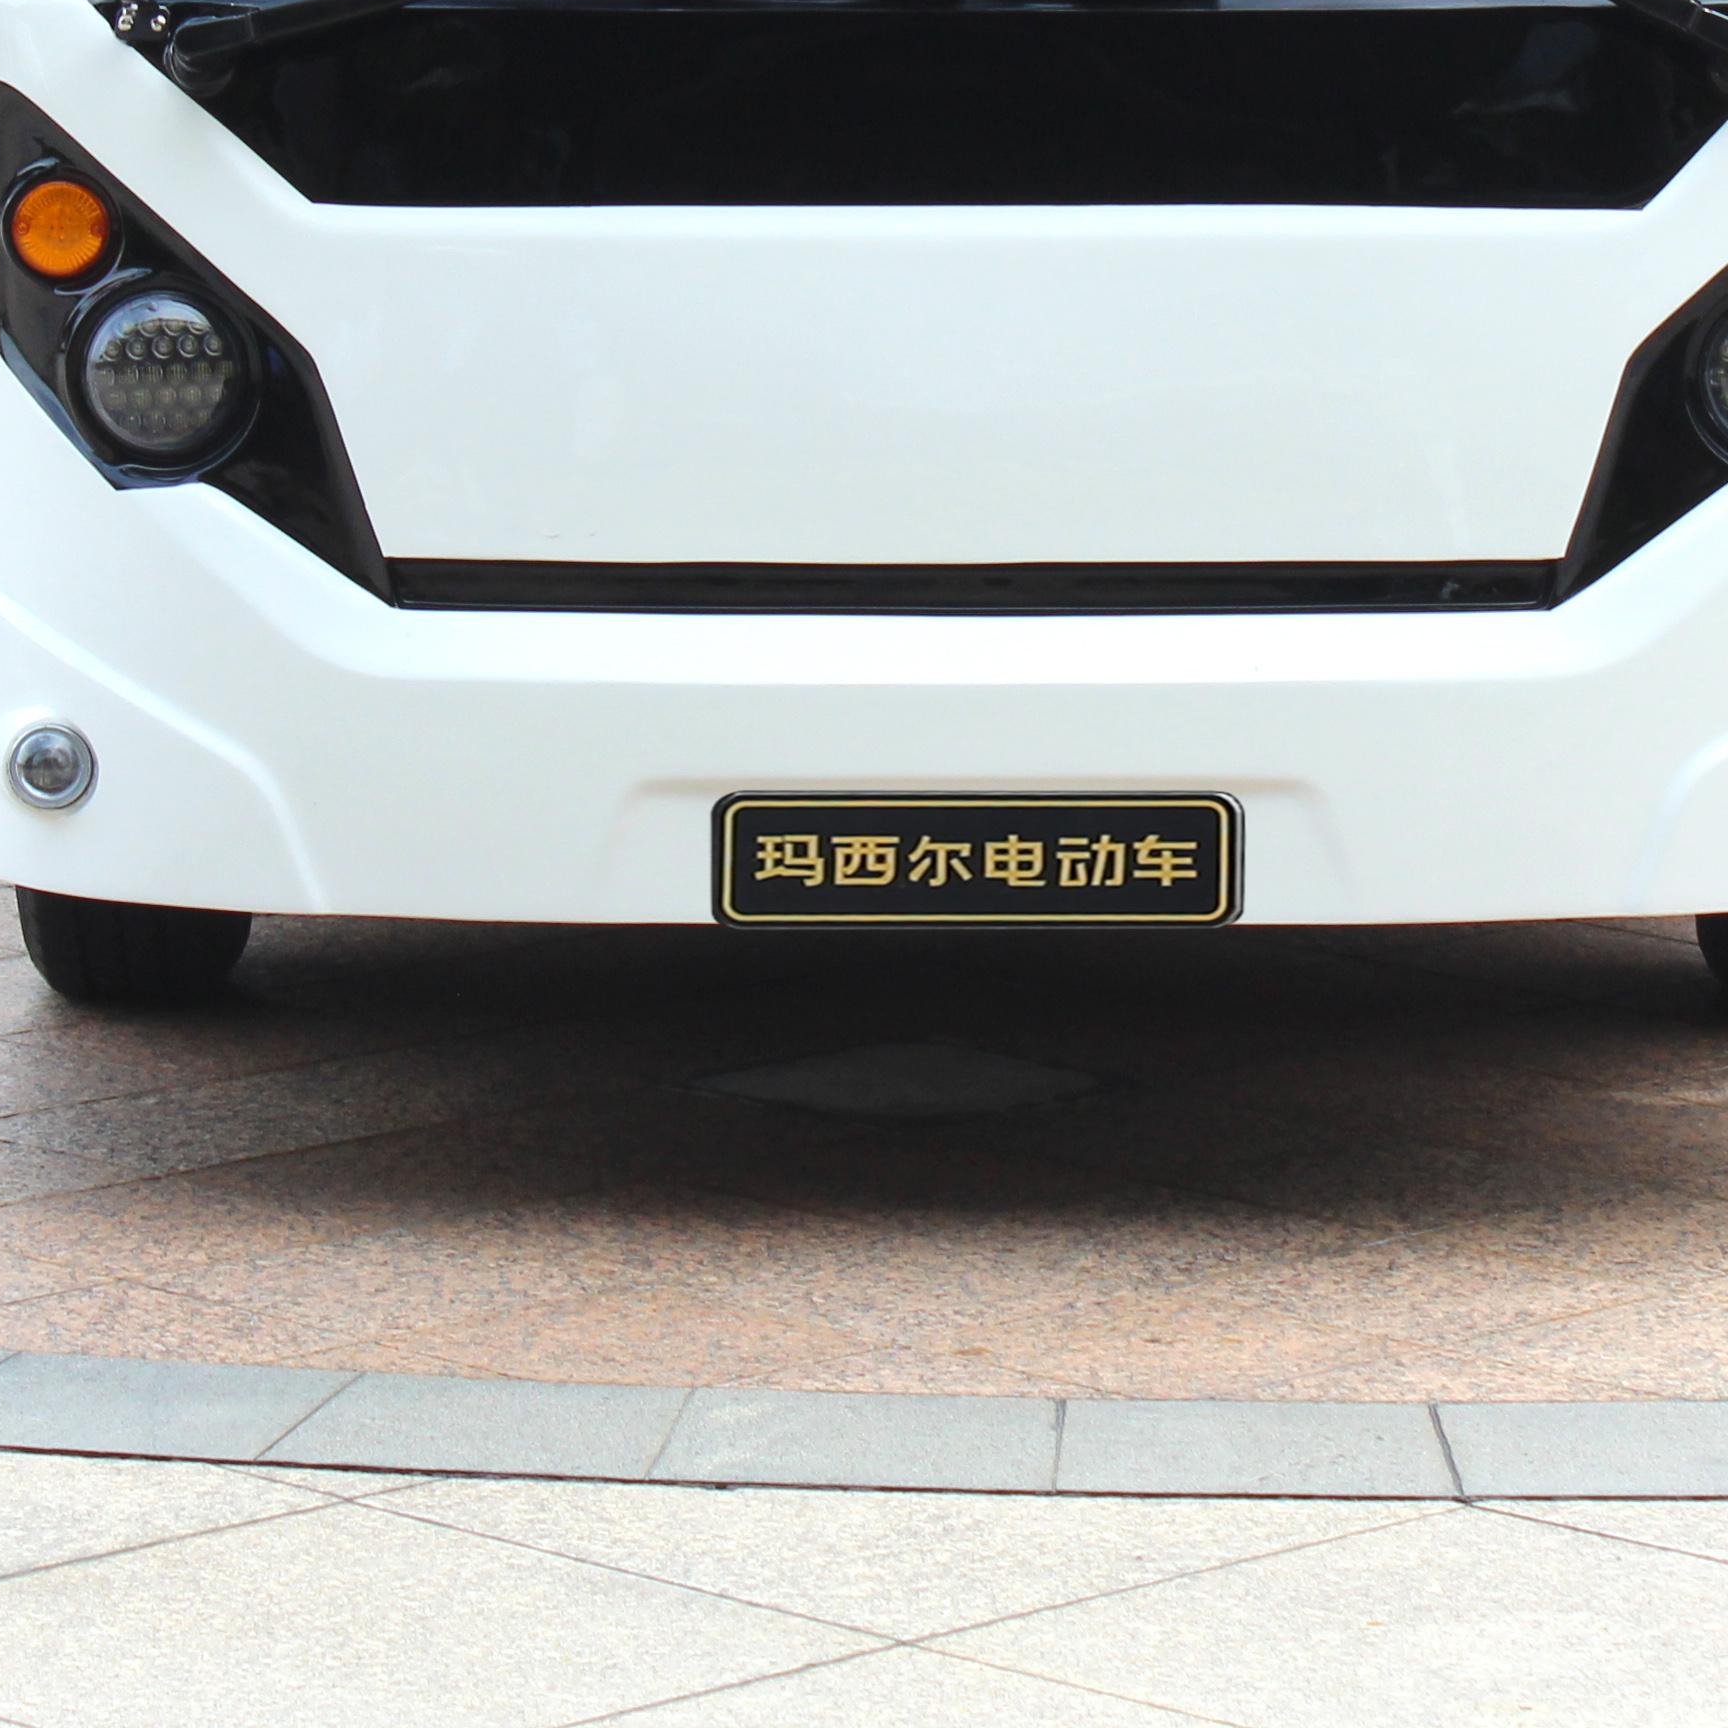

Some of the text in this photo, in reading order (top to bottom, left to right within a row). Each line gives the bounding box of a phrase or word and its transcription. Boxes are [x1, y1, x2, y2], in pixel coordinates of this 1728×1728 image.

[754, 834, 1198, 887] 玛西尔电动车
